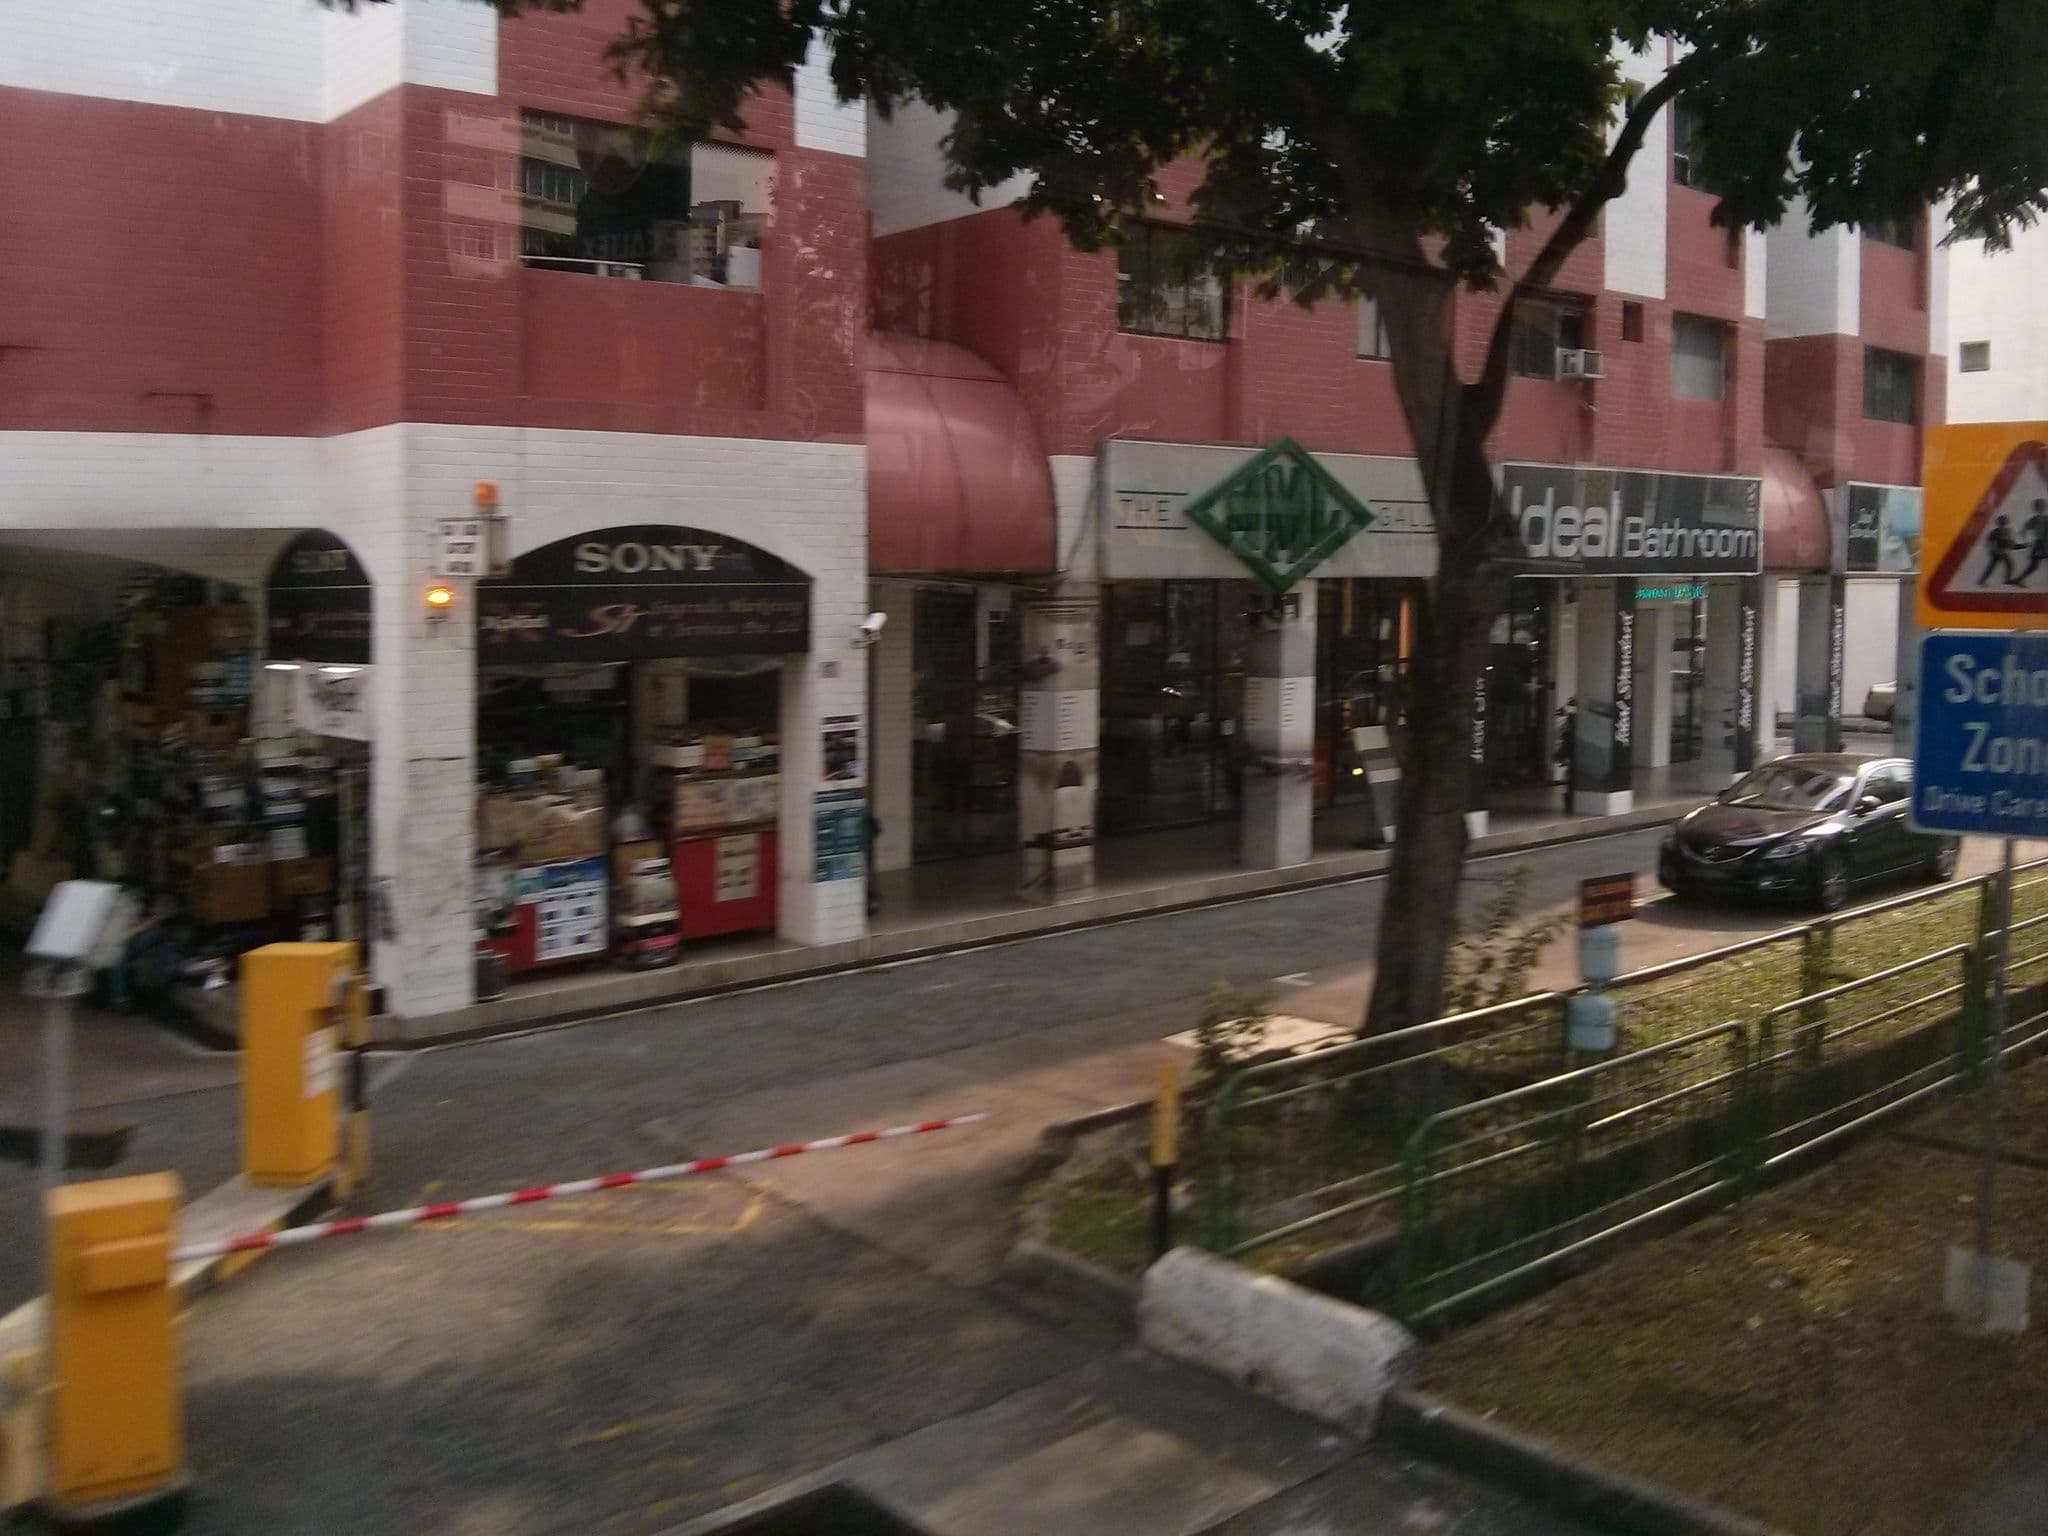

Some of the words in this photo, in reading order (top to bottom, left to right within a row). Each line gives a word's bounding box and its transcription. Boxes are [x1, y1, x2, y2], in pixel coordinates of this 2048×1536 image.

[1119, 499, 1169, 521] THE
[1622, 516, 1757, 558] Bathroom
[575, 542, 722, 573] SONY
[1960, 721, 2048, 775] Zon
